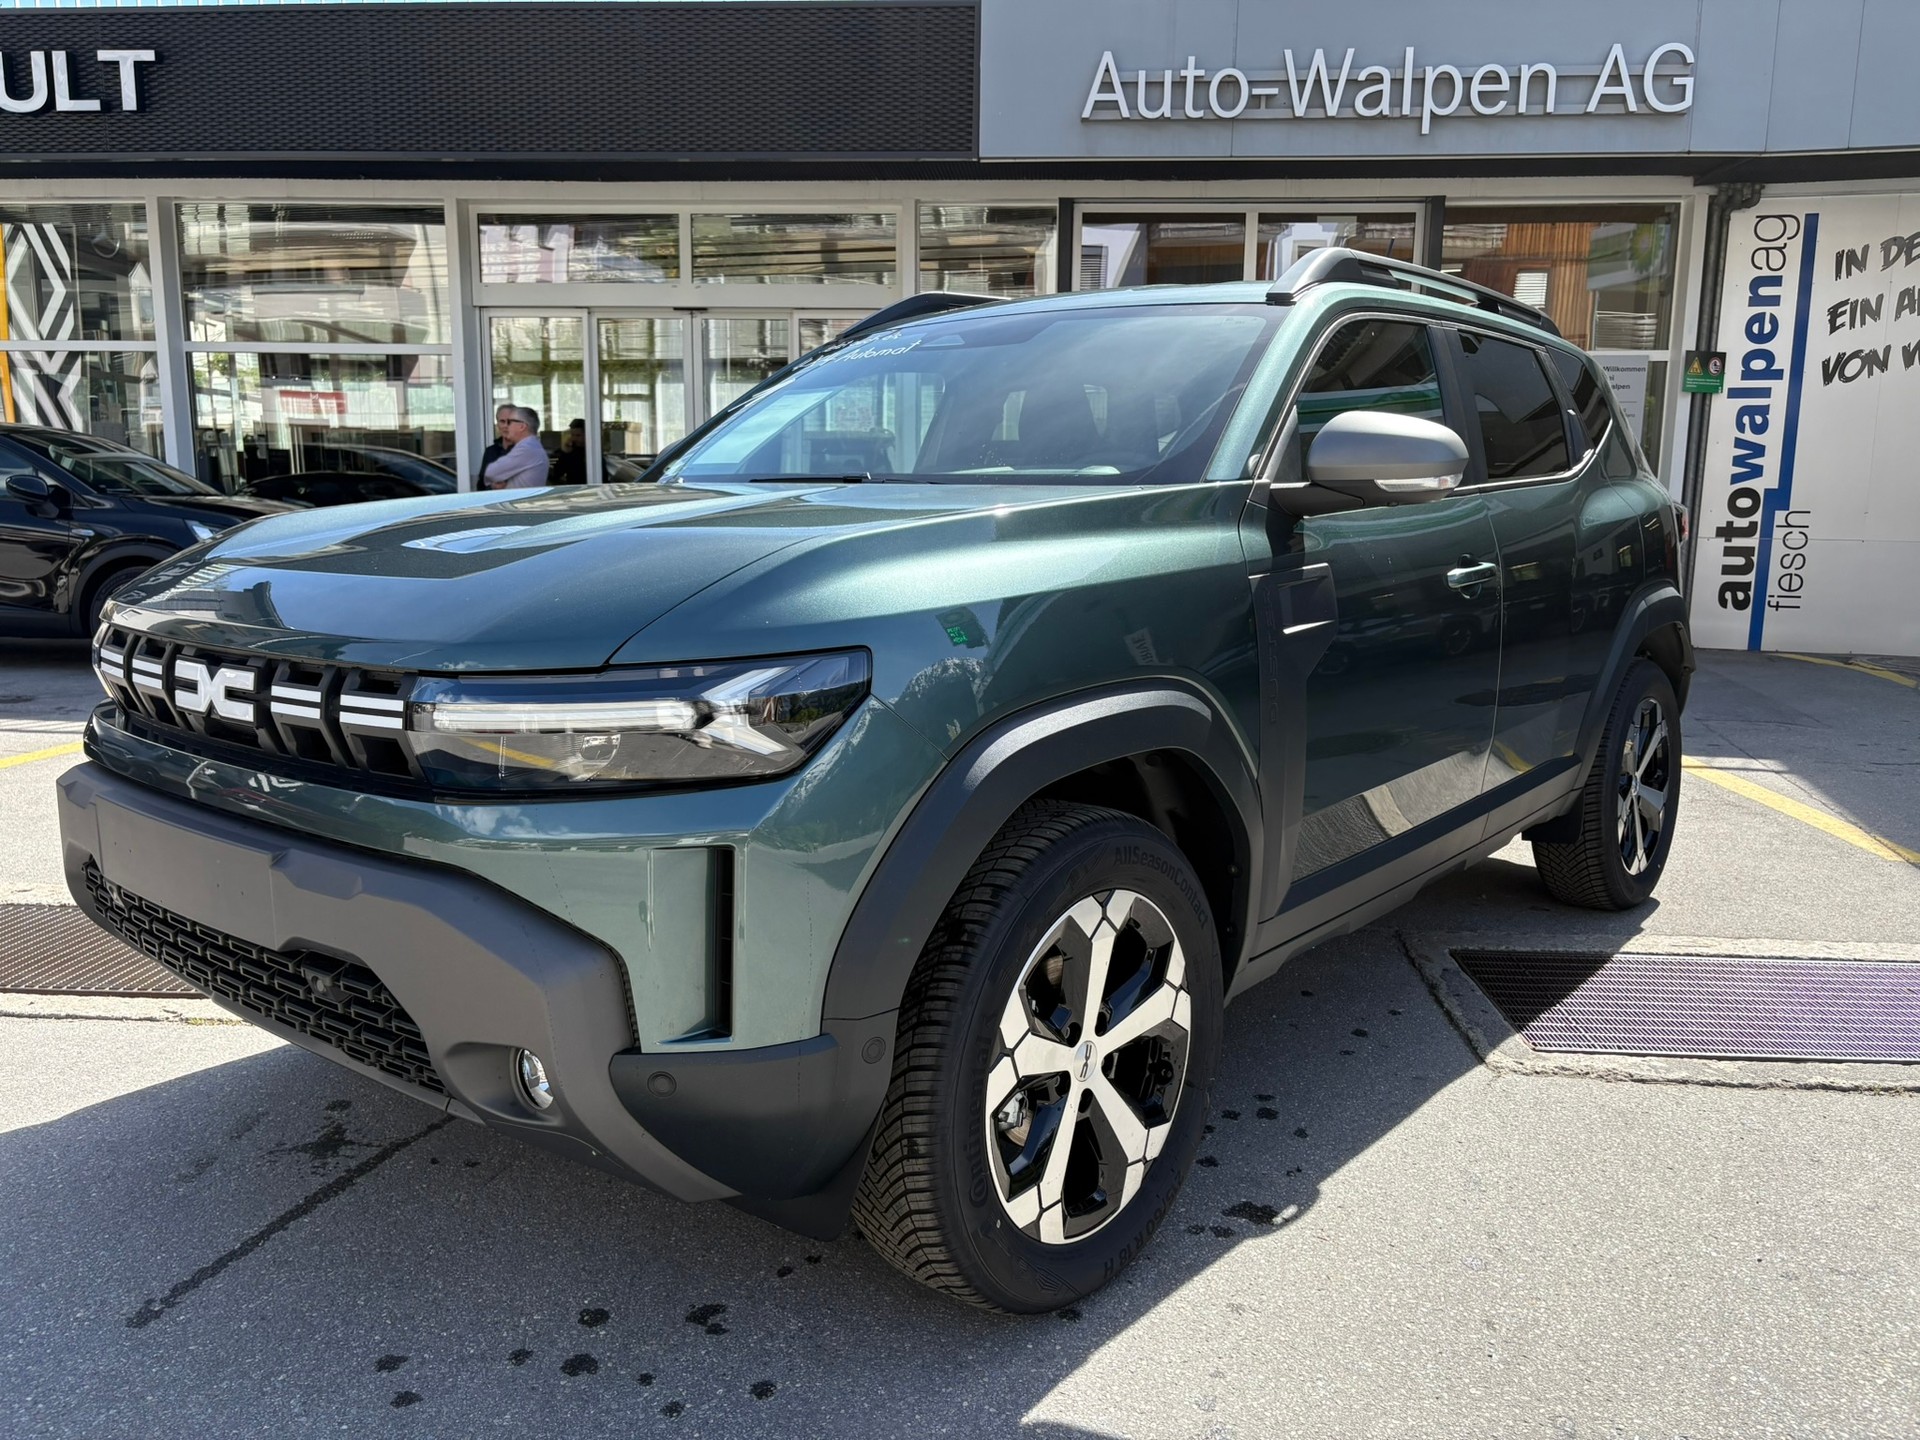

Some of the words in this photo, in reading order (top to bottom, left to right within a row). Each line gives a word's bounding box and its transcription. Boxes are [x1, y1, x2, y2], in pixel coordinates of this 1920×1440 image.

[0, 49, 156, 113] ULT
[1081, 46, 1557, 134] Auto-Walpen
[1586, 42, 1694, 113] AG
[1835, 243, 1870, 282] IN
[1826, 293, 1884, 336] EIN
[1894, 285, 1920, 322] A
[1602, 365, 1647, 373] Willkommen
[1611, 383, 1631, 391] alpen
[1821, 344, 1892, 387] VON
[1767, 510, 1812, 612] fiesch
[1112, 845, 1209, 930] AllSeasonContact
[963, 1035, 992, 1208] Continental
